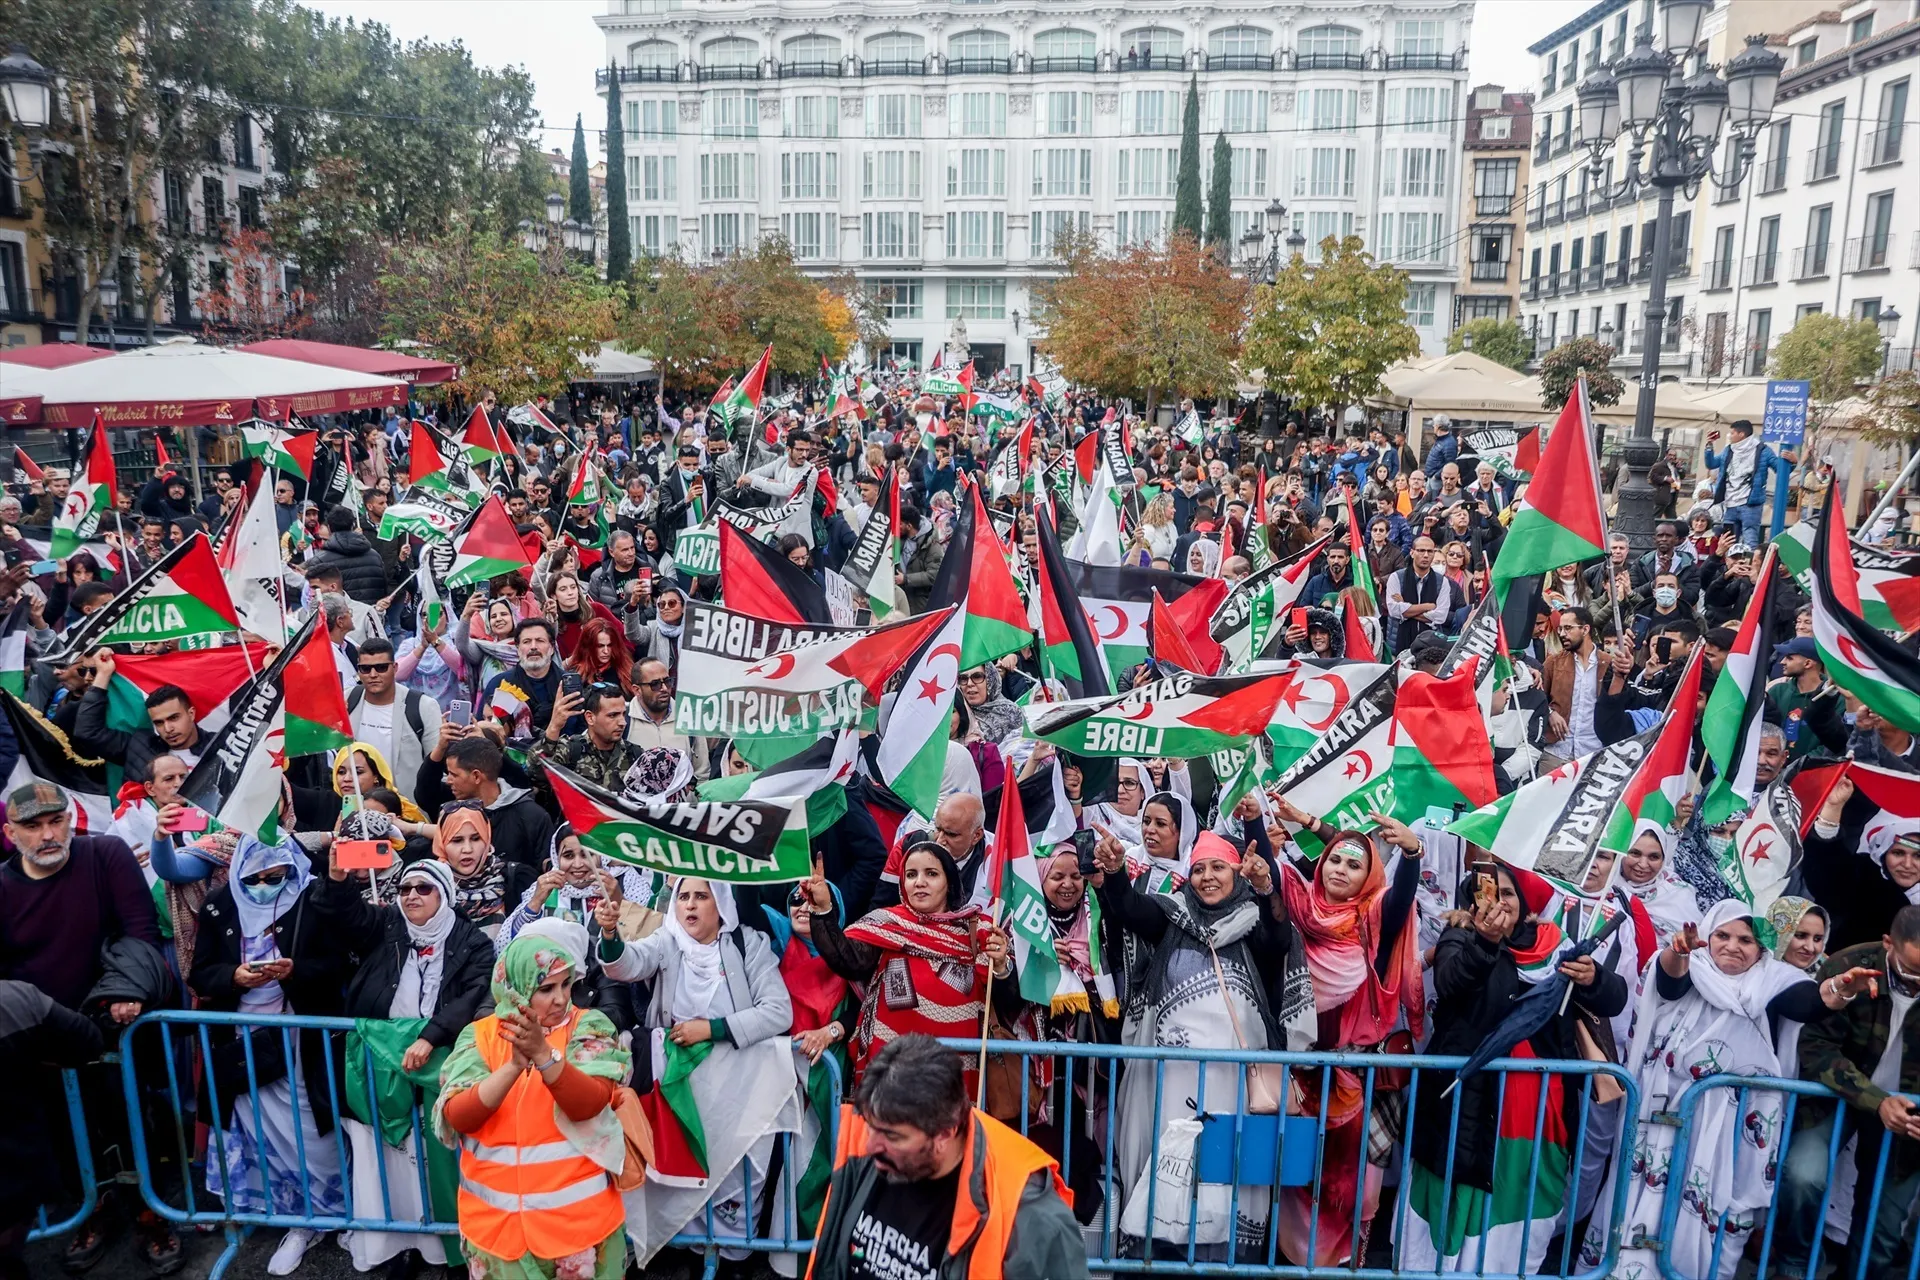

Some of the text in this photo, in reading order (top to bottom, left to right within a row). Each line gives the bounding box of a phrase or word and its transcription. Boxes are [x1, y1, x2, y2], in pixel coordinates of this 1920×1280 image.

[101, 404, 184, 421] Madrid 1904
[1006, 444, 1020, 481] SAHARA
[1105, 420, 1126, 478] SAHARA
[1280, 697, 1383, 783] SAHARA
[1551, 740, 1644, 853] SAHARA
[615, 832, 779, 873] GALICIA
[856, 1210, 930, 1270] MARCHA
[866, 1238, 938, 1280] libertad
